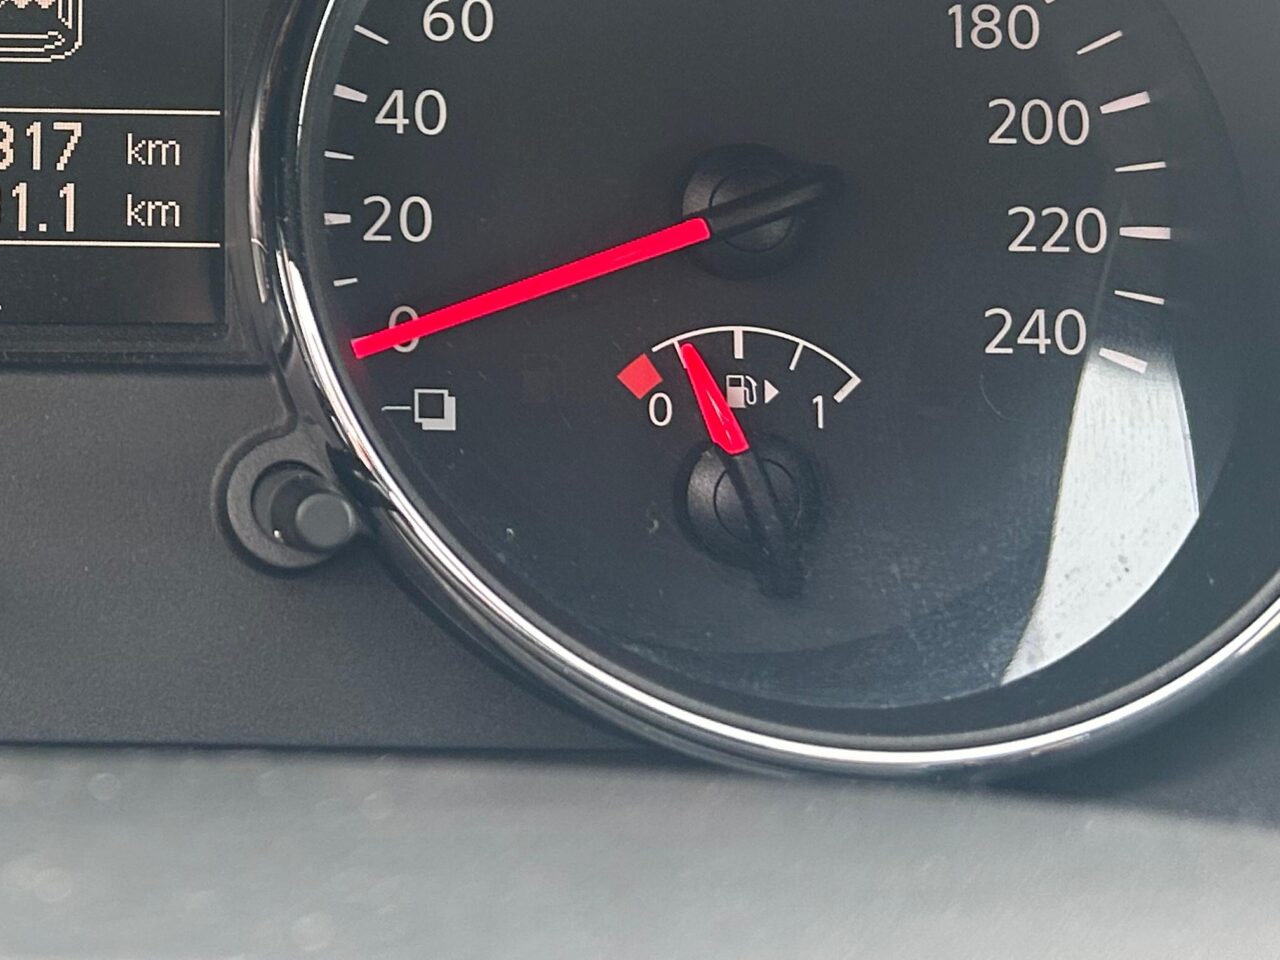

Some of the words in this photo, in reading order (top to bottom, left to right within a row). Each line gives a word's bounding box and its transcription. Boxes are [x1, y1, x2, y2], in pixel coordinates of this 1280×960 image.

[948, 3, 1040, 50] 180
[374, 89, 447, 136] 40
[988, 98, 1090, 146] 200
[127, 132, 180, 166] km
[126, 193, 180, 227] km
[363, 195, 433, 243] 20
[1007, 206, 1108, 254] 220
[984, 307, 1087, 356] 240
[648, 392, 673, 427] 0
[812, 395, 824, 429] 1
